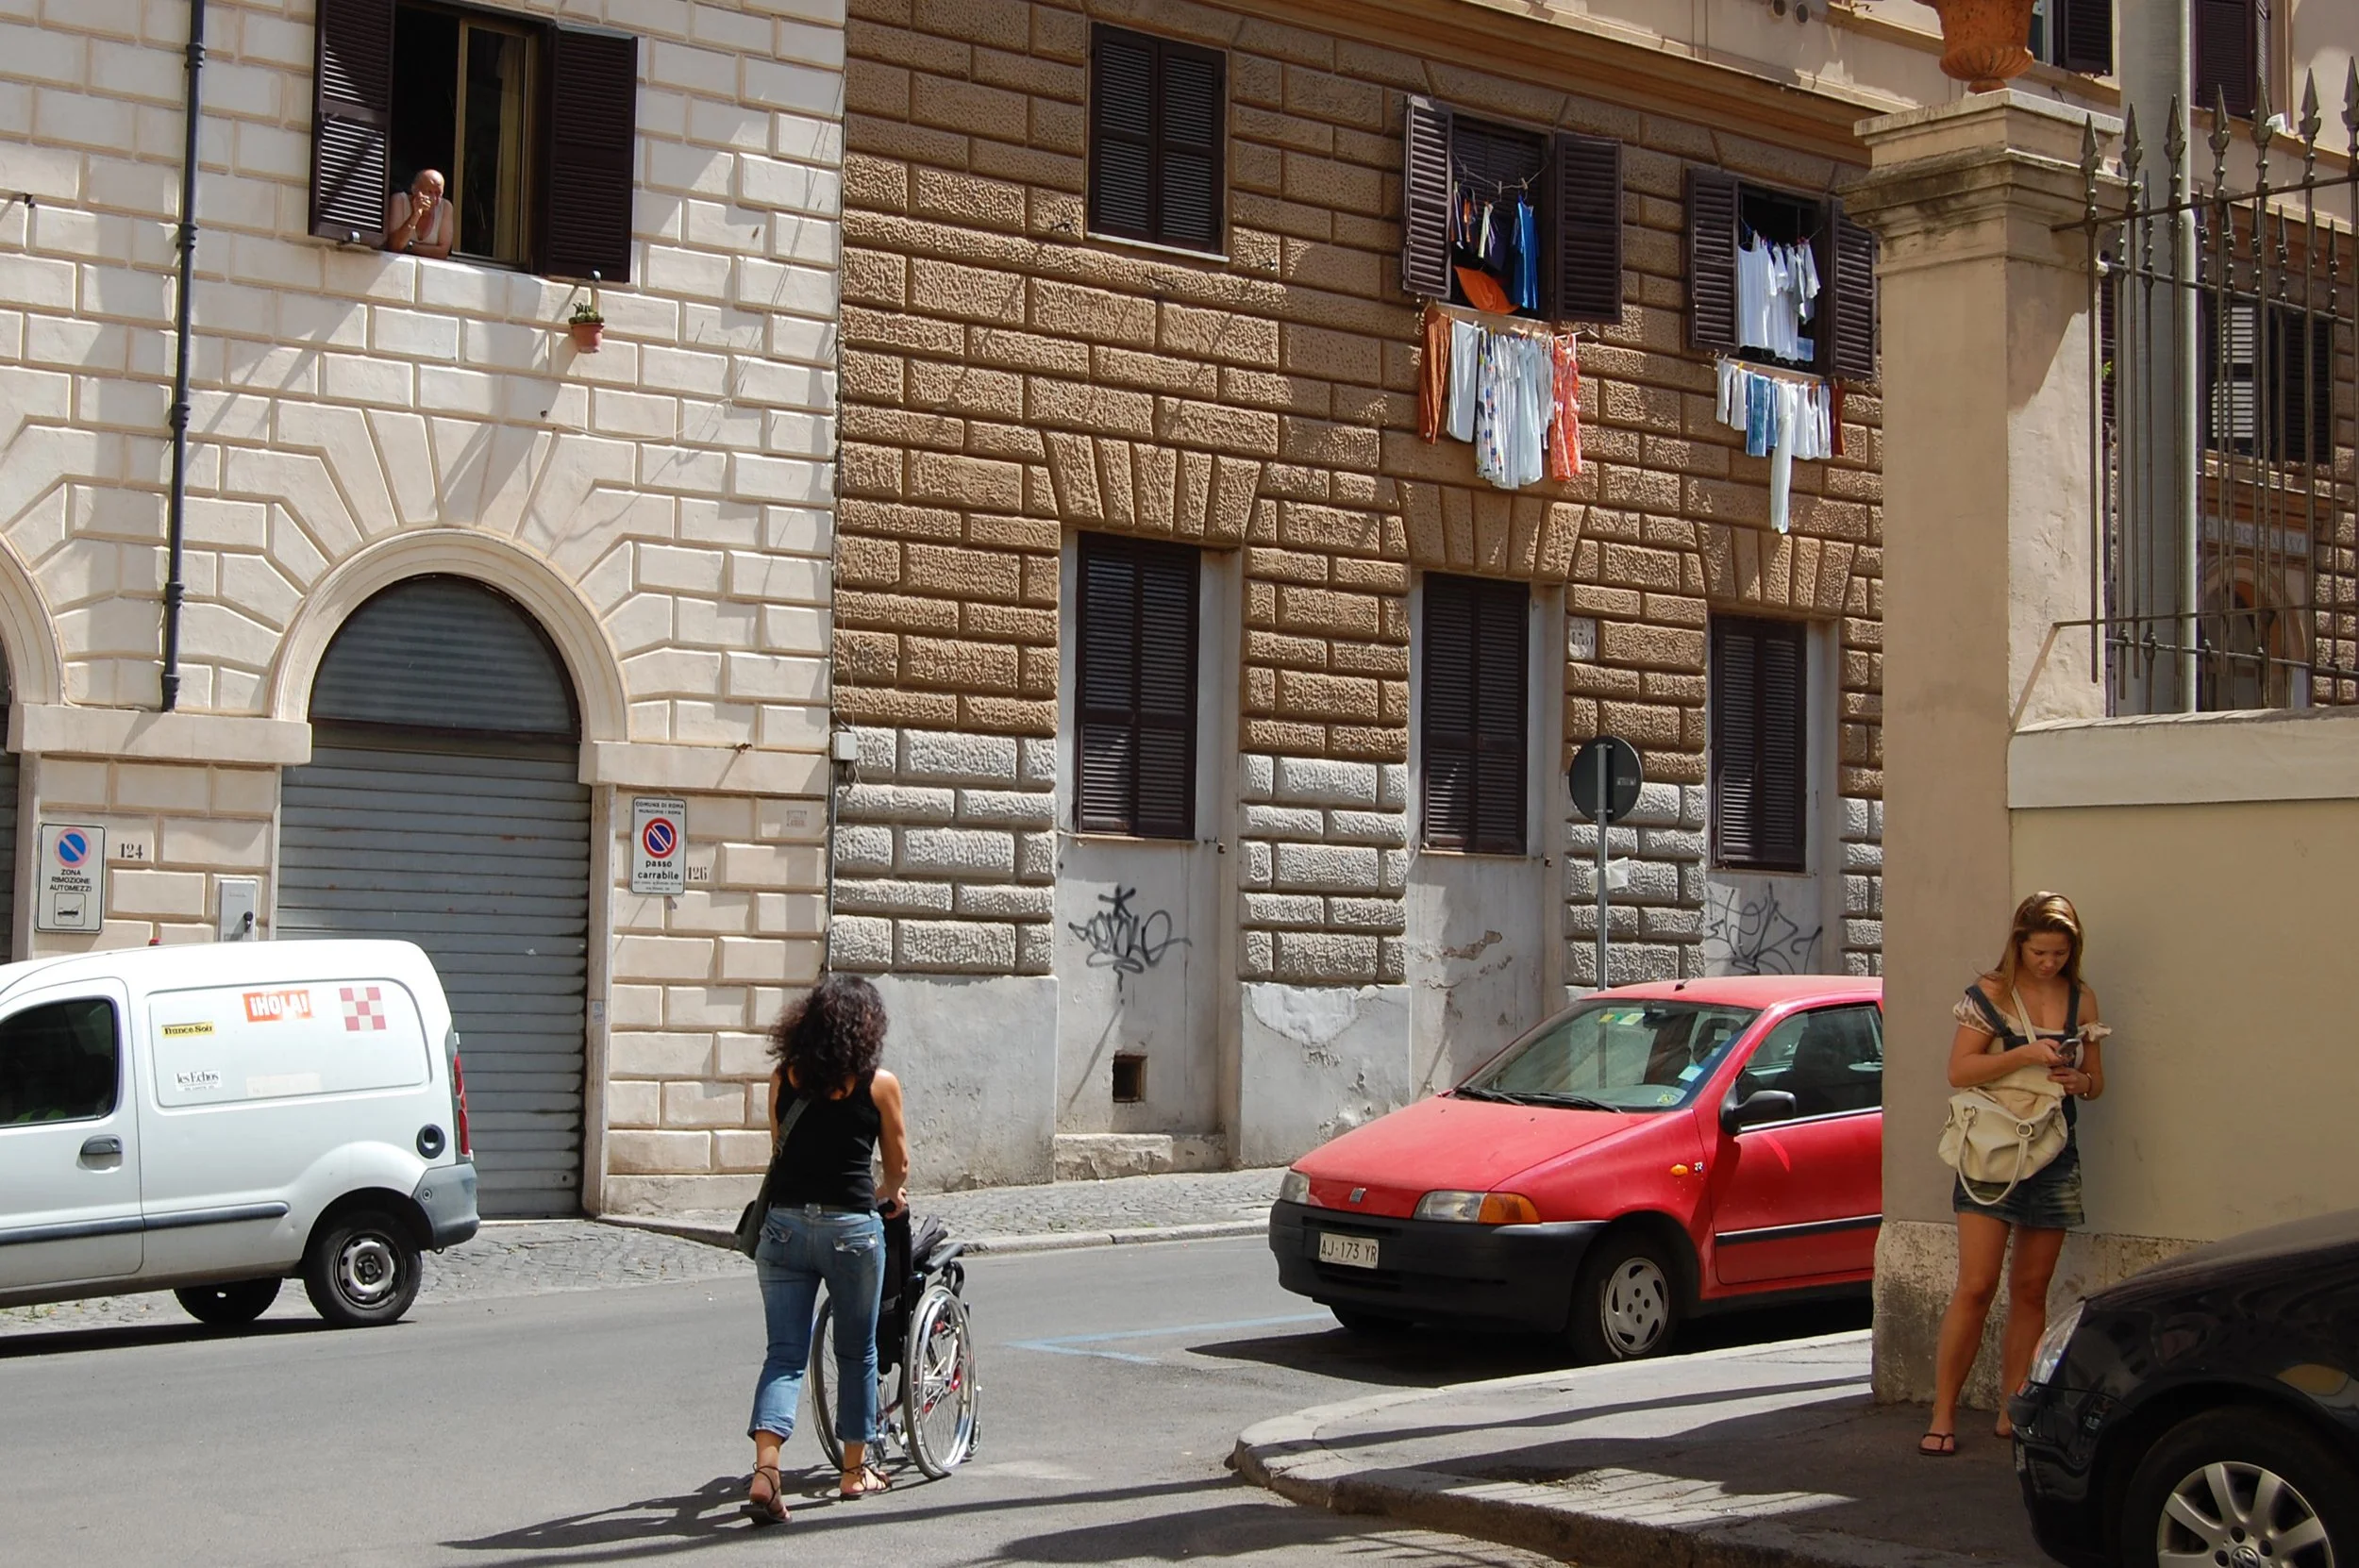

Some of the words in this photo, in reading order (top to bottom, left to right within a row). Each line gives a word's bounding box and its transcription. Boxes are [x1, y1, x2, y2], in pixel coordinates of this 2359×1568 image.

[121, 842, 142, 859] 124
[645, 859, 673, 868] passo
[638, 871, 679, 880] carrabile
[688, 866, 708, 880] 126
[1364, 1244, 1378, 1262] YR
